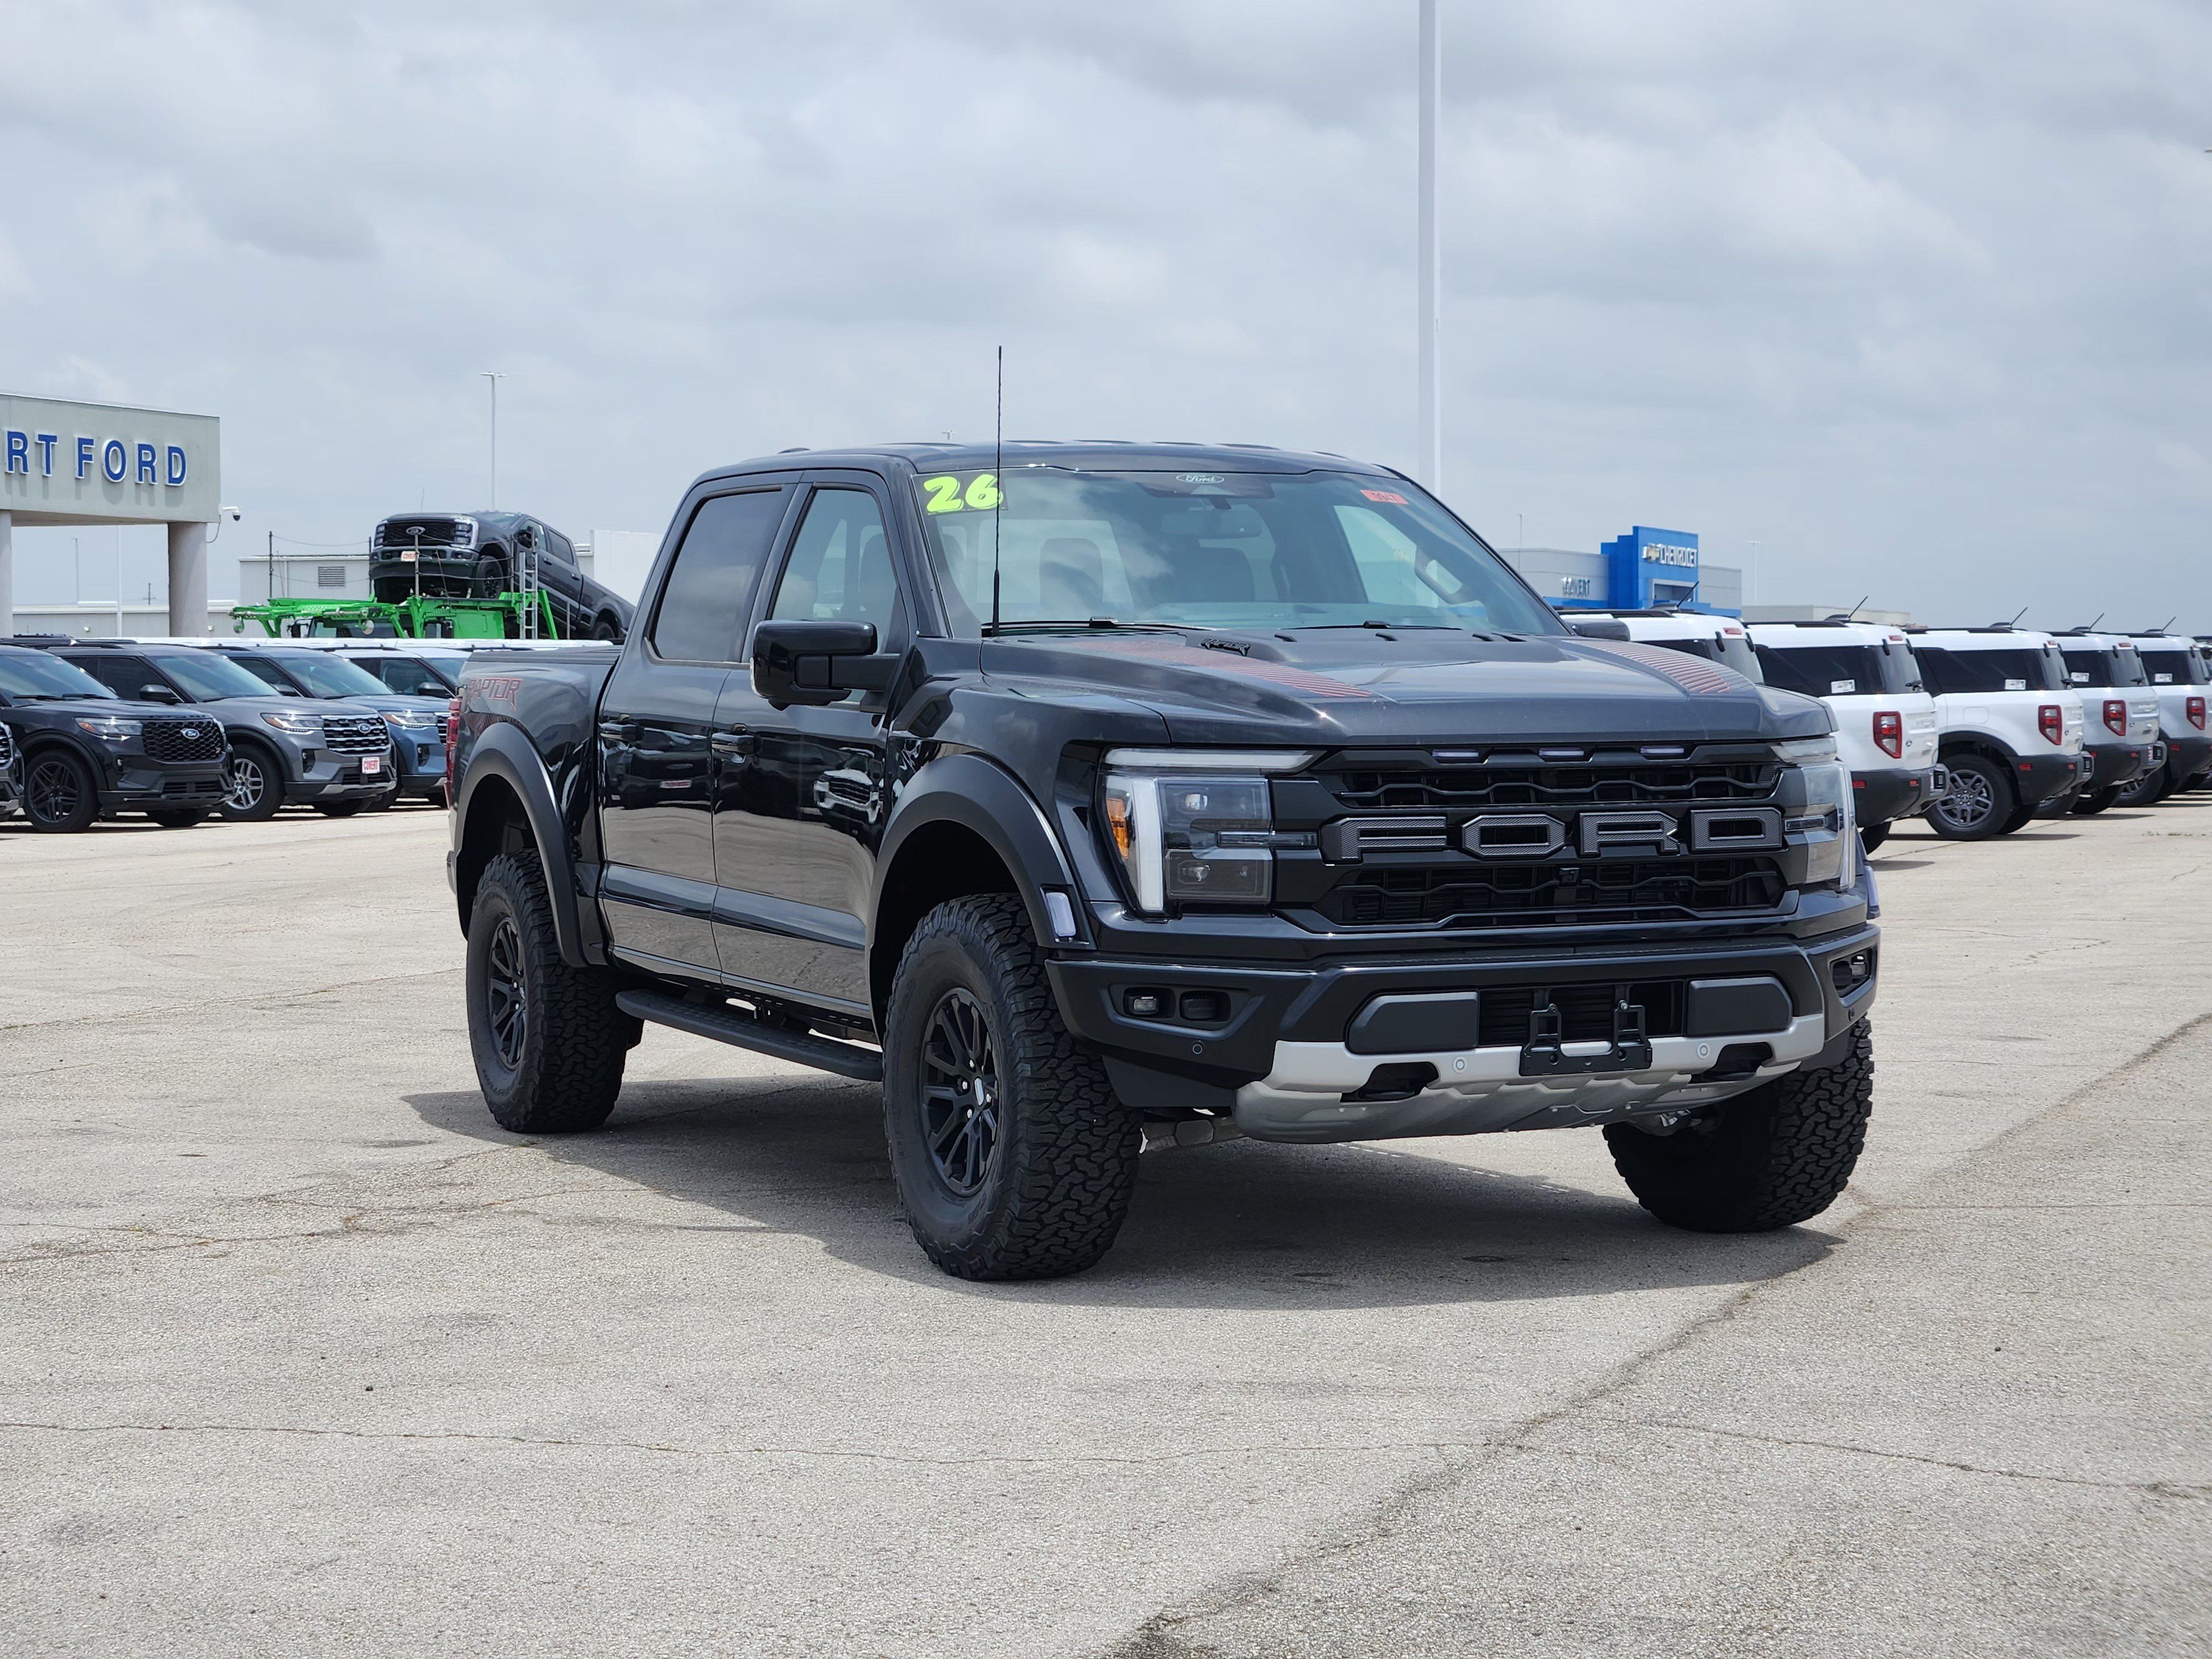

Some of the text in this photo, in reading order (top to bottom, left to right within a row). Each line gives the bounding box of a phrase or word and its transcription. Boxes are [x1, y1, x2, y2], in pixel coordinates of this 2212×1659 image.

[75, 436, 188, 487] FORD
[924, 474, 1003, 513] 26
[1659, 544, 1697, 568] CHEVROLET
[1562, 577, 1590, 597] COVERT
[1200, 638, 1251, 656] RAPTOR
[468, 677, 523, 712] RAPTOR
[1339, 807, 1782, 860] FORD
